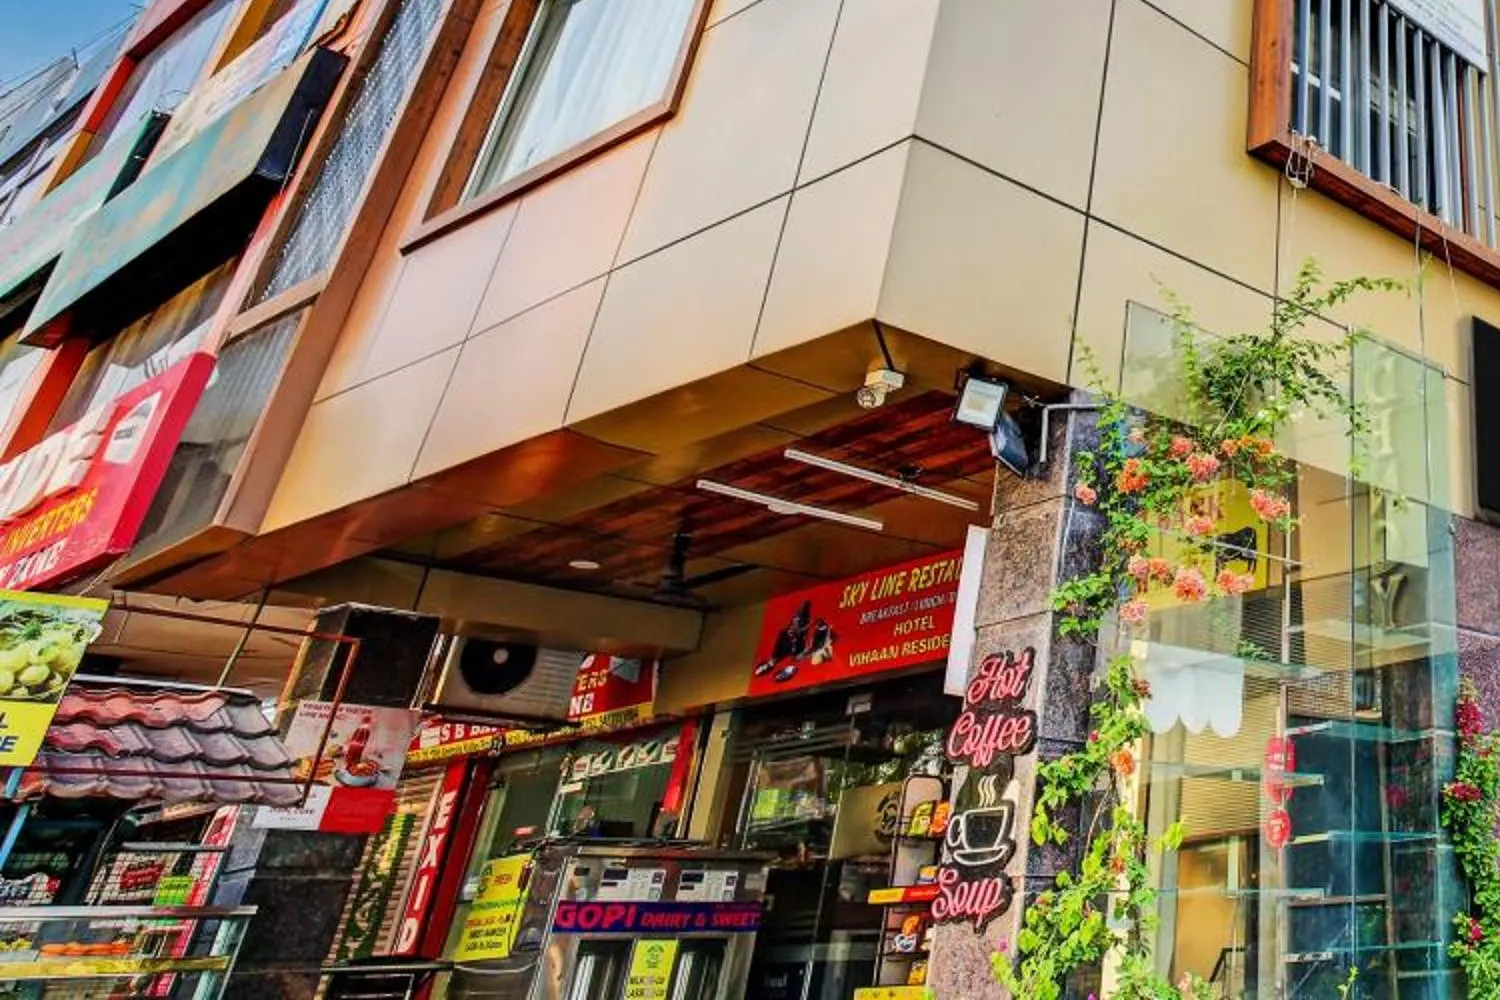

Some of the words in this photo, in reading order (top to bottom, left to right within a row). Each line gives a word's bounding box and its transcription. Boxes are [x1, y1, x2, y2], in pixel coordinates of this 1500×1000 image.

[839, 580, 869, 609] SKY
[870, 571, 907, 601] LINE
[894, 615, 936, 637] HOTEL
[849, 645, 900, 667] VIHAAN
[968, 652, 1031, 704] Hot
[950, 711, 1031, 768] Coffee
[931, 866, 1004, 928] Soup
[555, 903, 637, 930] GOPI
[640, 912, 692, 929] DAIRY
